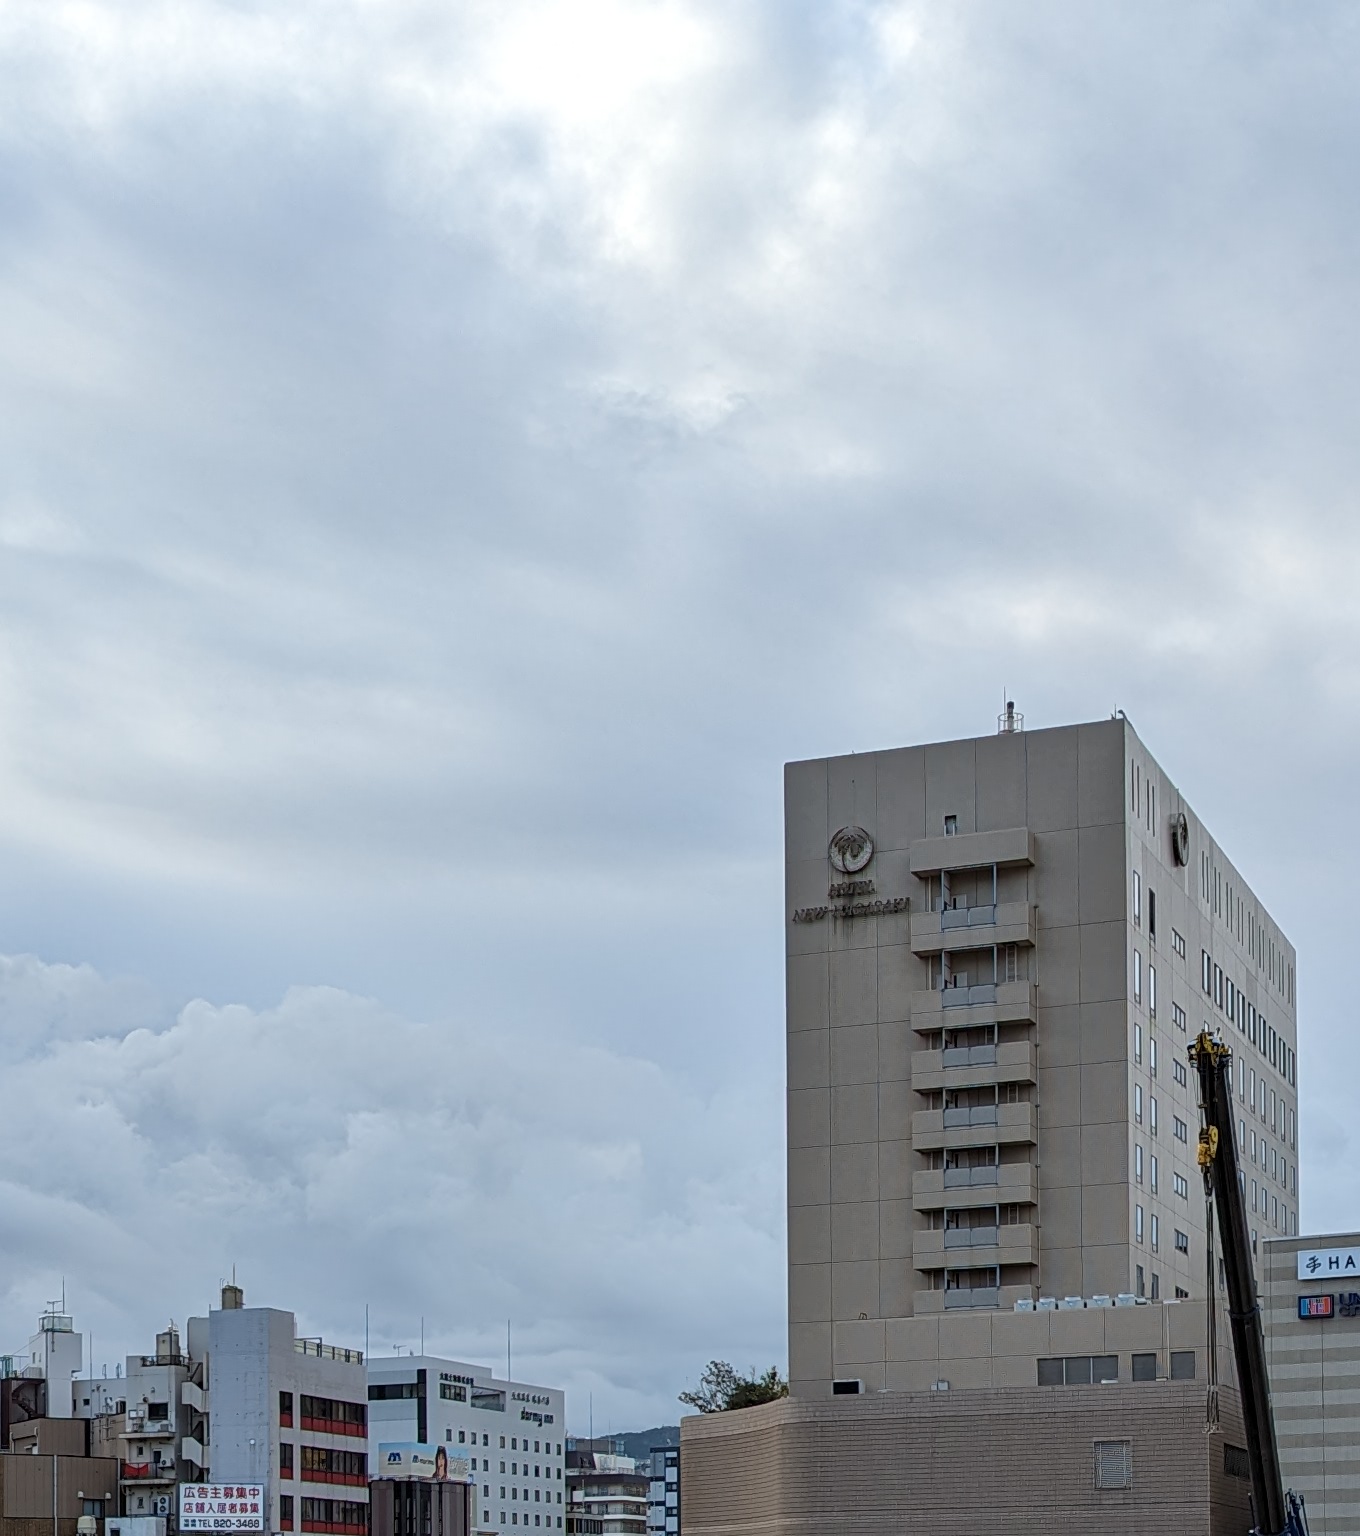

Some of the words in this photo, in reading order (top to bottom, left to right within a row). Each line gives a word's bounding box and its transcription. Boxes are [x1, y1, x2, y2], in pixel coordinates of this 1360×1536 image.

[183, 1486, 260, 1500] 広告主募集中
[183, 1502, 260, 1515] 店舗入居者募集
[198, 1519, 212, 1529] TEL
